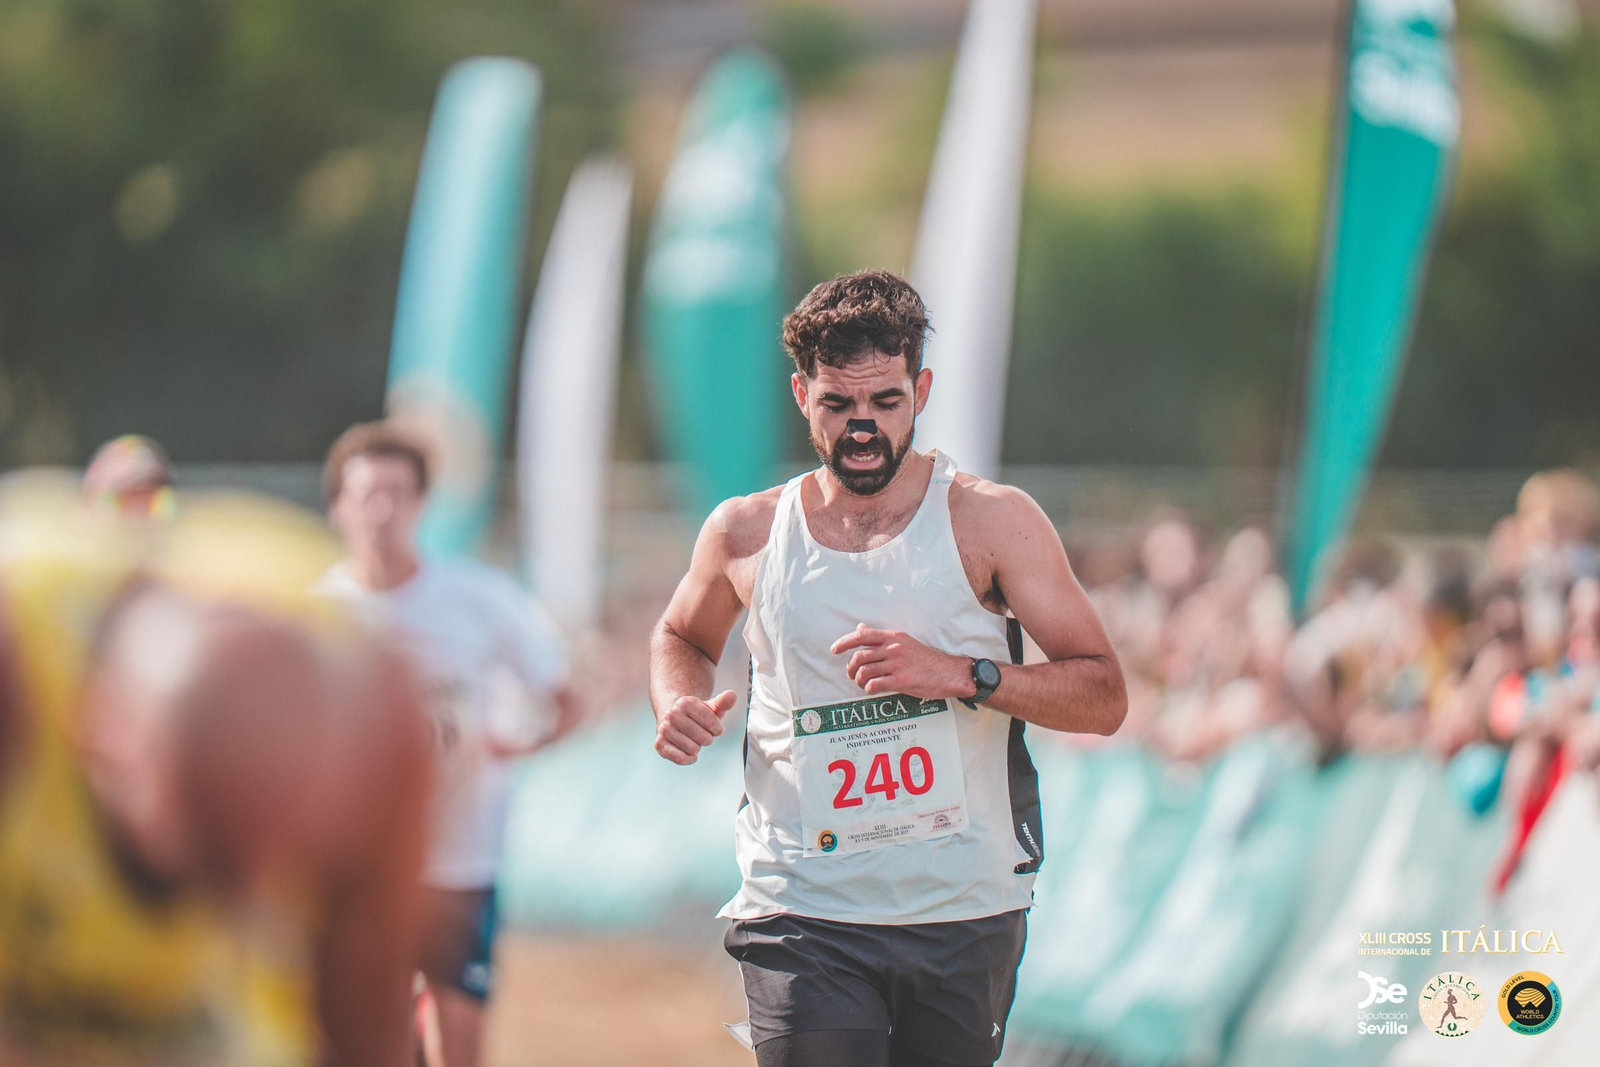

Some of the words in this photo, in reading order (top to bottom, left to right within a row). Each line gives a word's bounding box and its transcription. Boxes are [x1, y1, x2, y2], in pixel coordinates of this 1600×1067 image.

[831, 699, 908, 726] ITÁLICA
[829, 735, 846, 744] JUAN
[847, 730, 868, 741] JESÚS
[869, 728, 897, 738] ACOSTA
[897, 723, 917, 733] POZO
[846, 734, 902, 749] INDEPENDIENTE
[827, 746, 935, 810] 240
[860, 828, 893, 838] INTERNACIONAL
